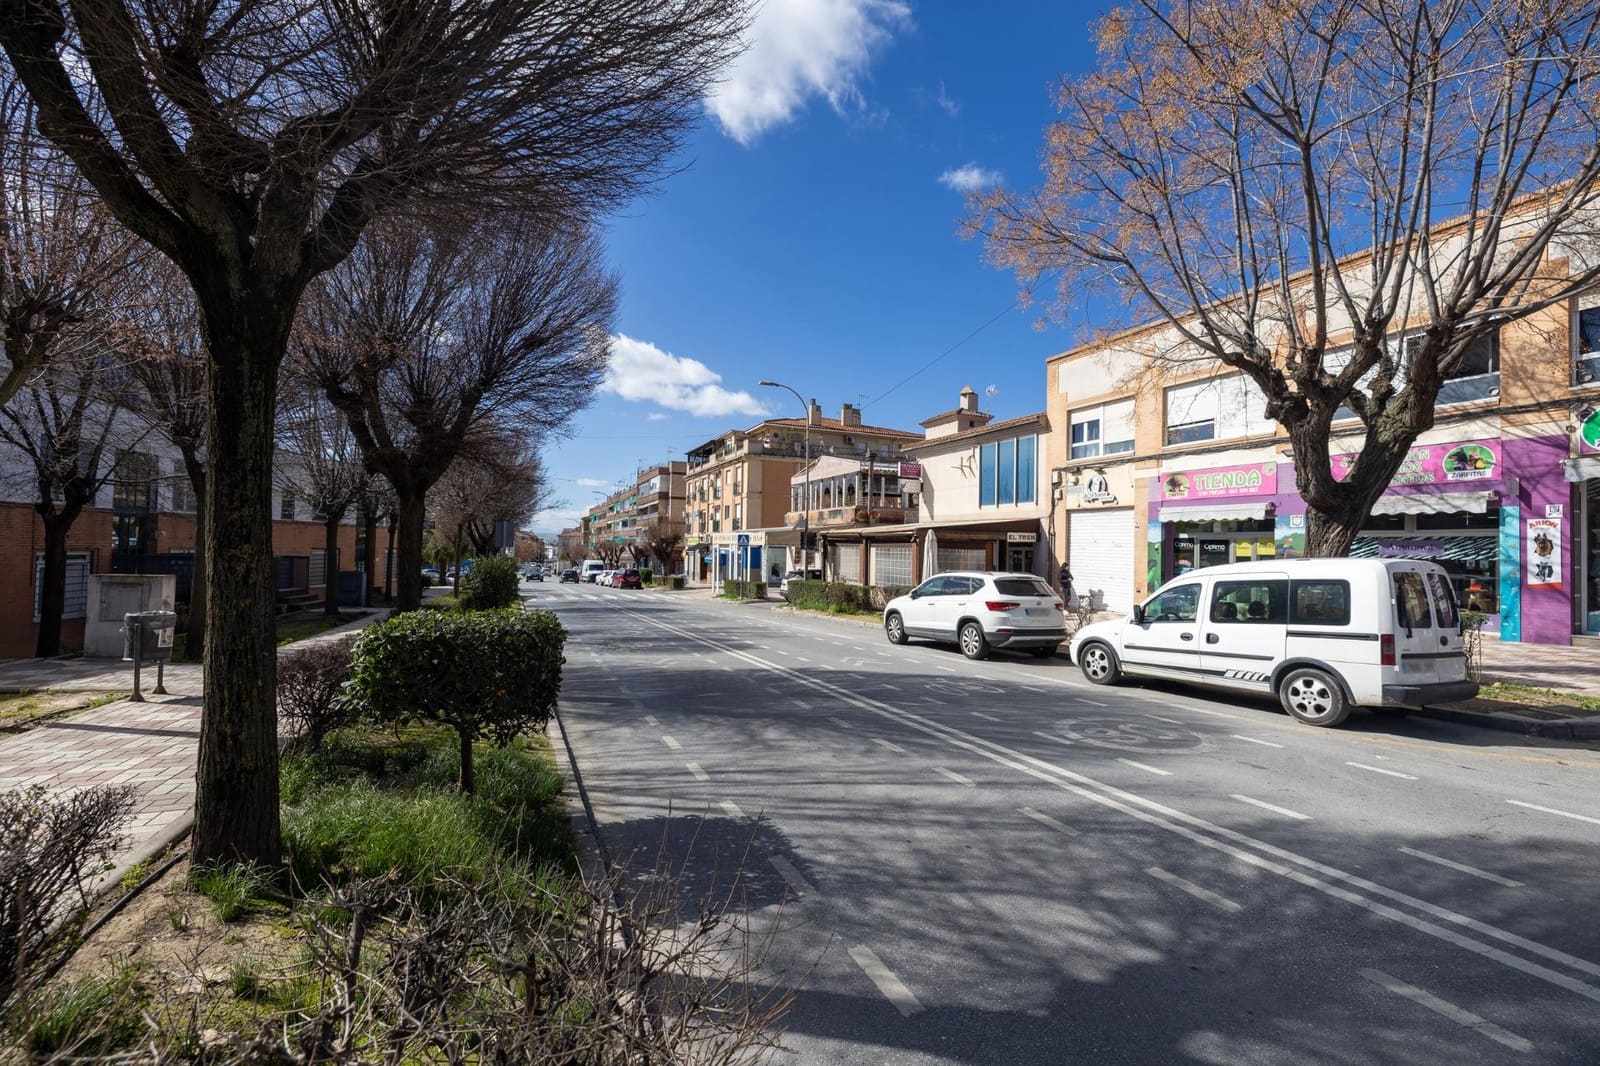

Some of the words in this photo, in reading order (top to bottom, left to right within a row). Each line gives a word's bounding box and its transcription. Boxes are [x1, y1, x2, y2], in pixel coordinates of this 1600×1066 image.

[1195, 469, 1262, 489] TIENDA
[1451, 470, 1487, 479] ZARPITAS
[1529, 520, 1559, 529] ARION
